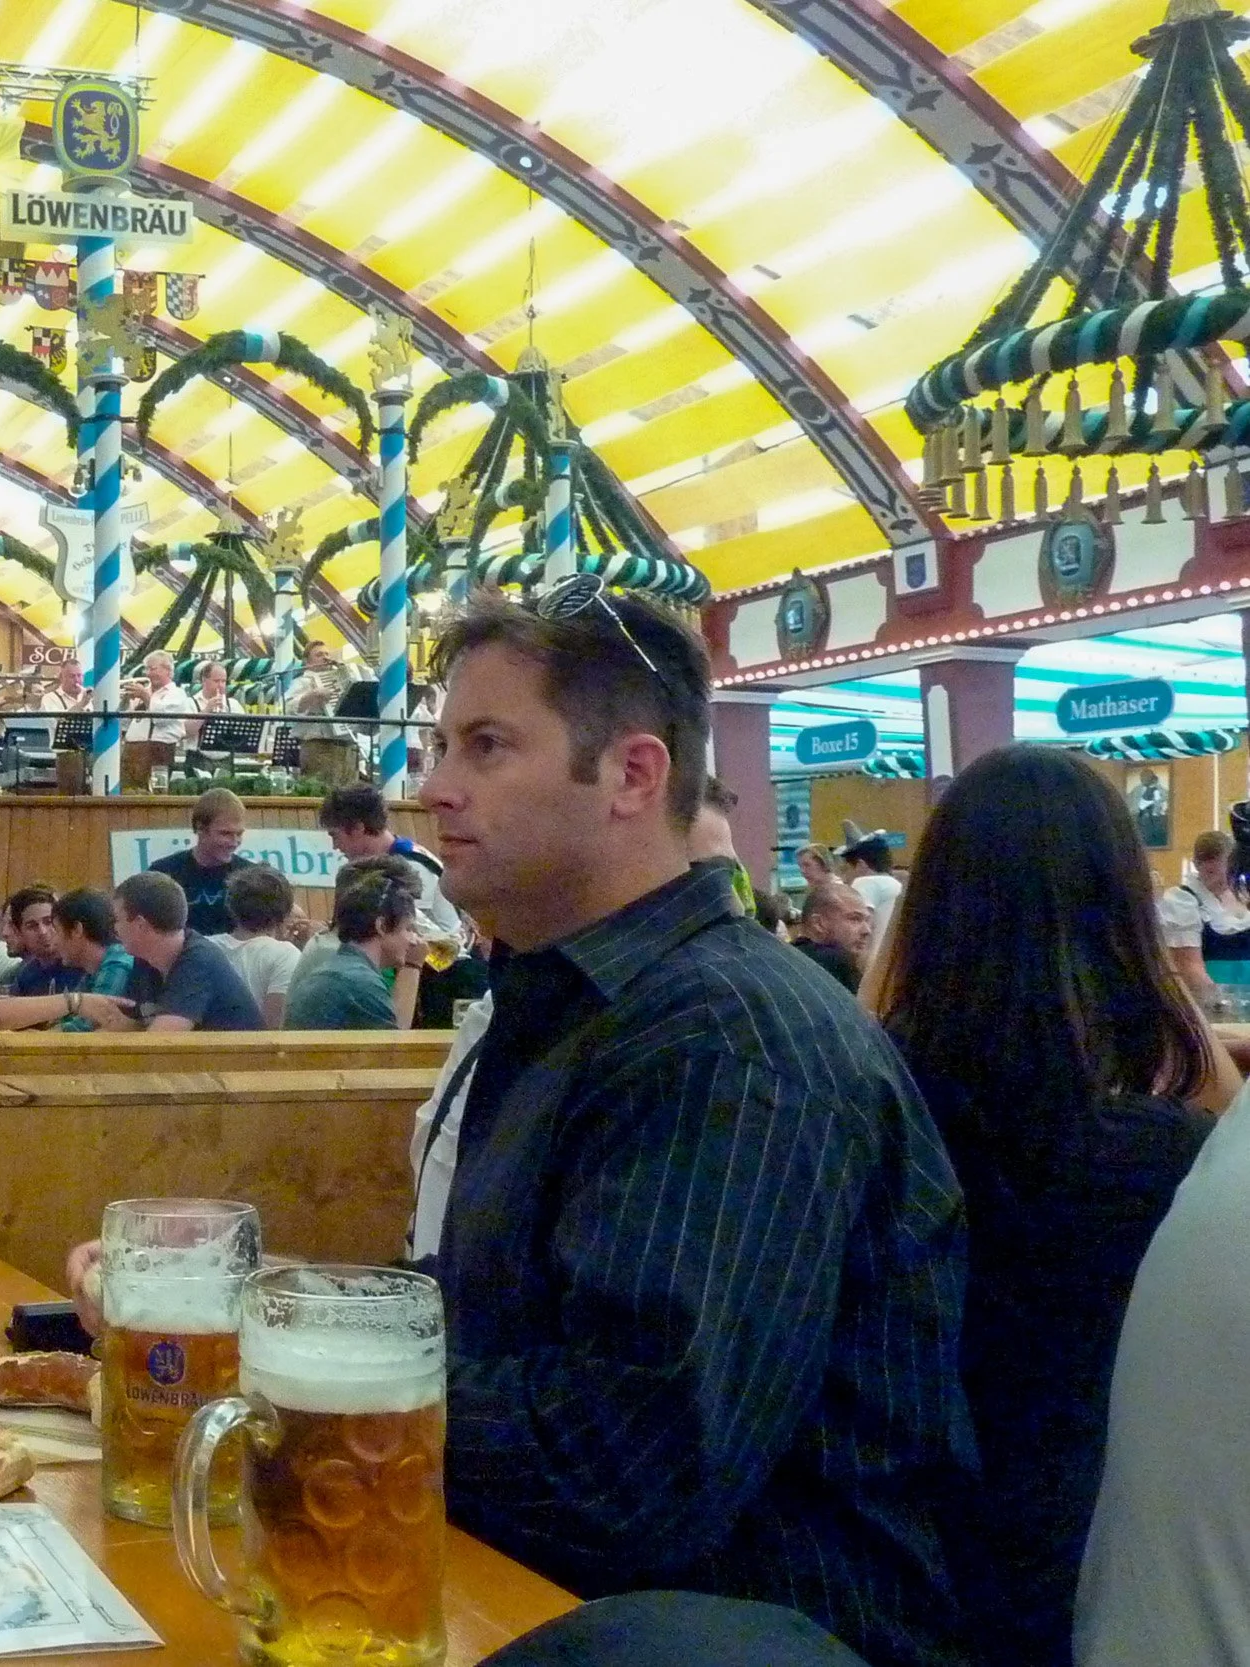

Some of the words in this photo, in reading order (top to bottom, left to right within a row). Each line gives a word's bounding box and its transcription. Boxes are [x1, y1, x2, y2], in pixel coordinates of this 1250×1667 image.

[12, 193, 187, 236] LÖWENBRÄU
[1069, 694, 1159, 721] Mathäser
[844, 732, 859, 751] 15
[134, 835, 349, 876] Lenbr
